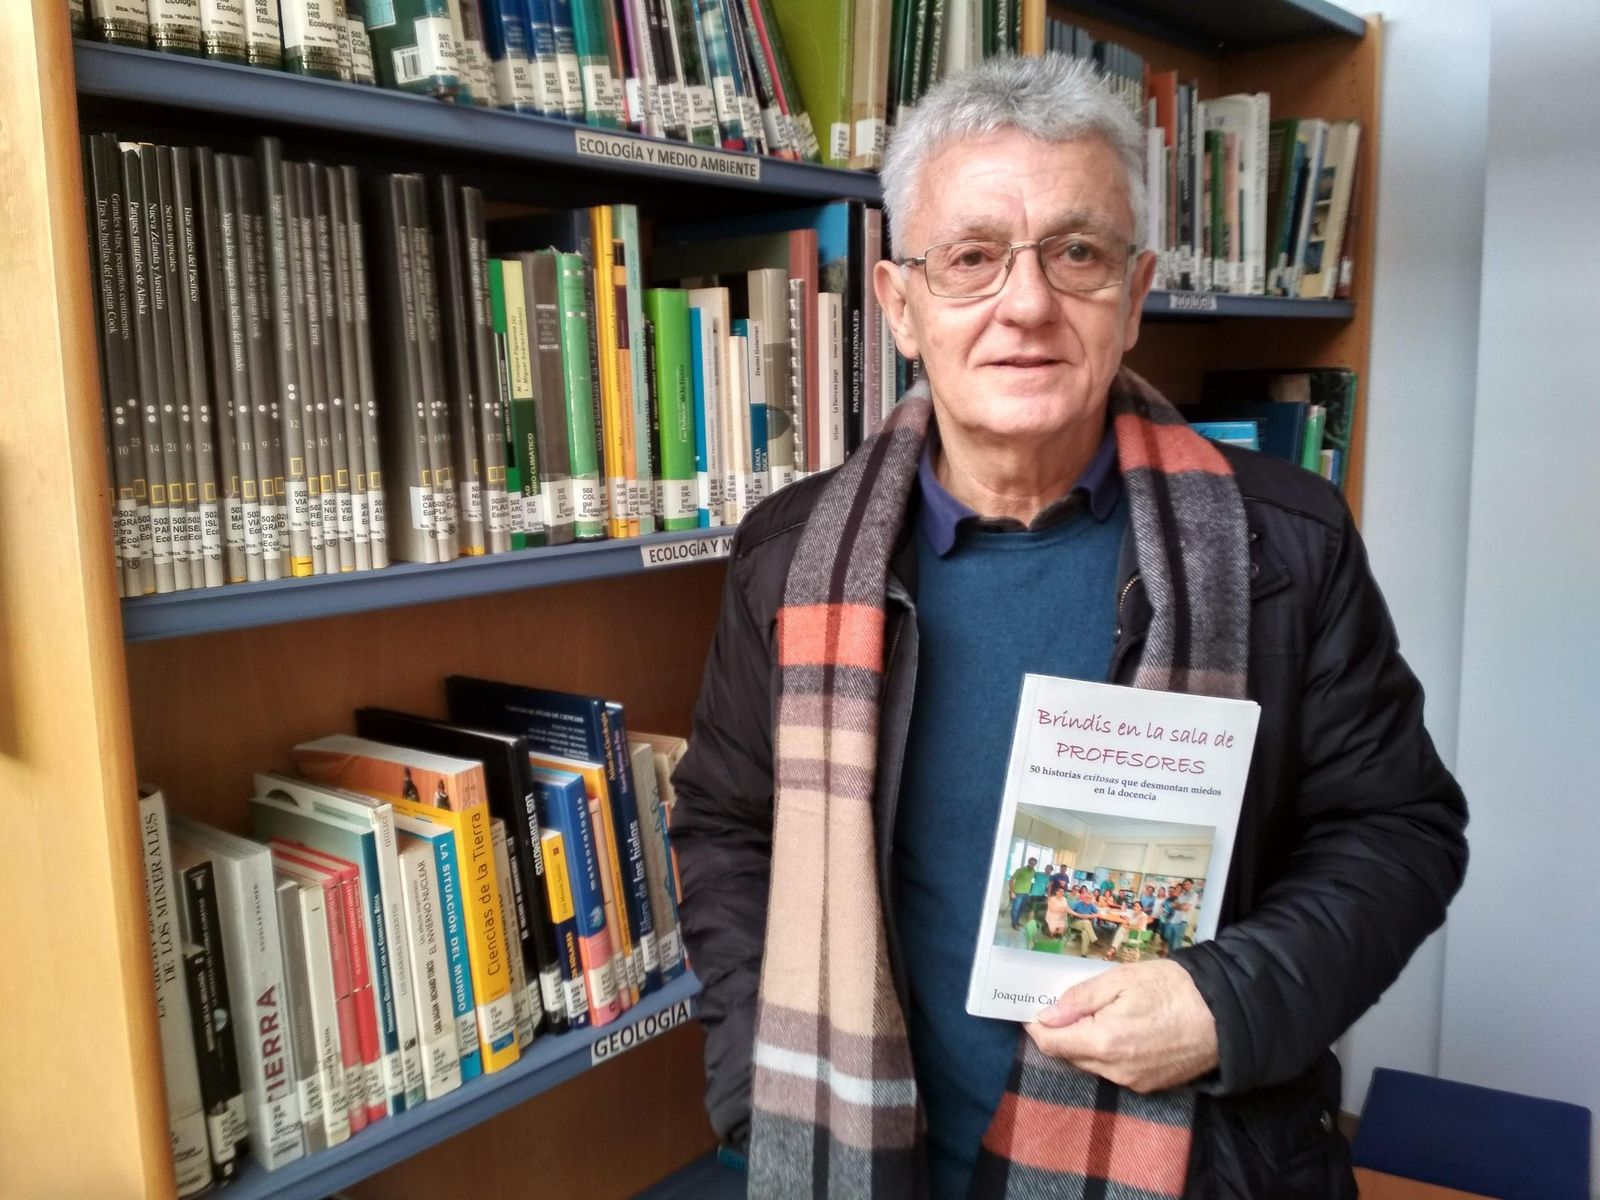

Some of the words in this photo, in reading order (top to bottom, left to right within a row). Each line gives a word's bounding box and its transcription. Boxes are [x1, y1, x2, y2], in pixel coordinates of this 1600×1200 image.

[579, 137, 644, 161] ECOLOGÍA
[646, 147, 654, 162] Y
[657, 150, 697, 168] MEDIO
[701, 156, 758, 177] AMBIENTE
[98, 200, 110, 217] Tras
[111, 193, 123, 227] Grandes
[128, 201, 141, 234] Parques
[148, 202, 160, 230] Nueva
[165, 204, 176, 232] Selvas
[184, 207, 194, 226] Islas
[100, 218, 110, 232] las
[222, 213, 234, 235] Viajes
[101, 232, 113, 263] huellas
[132, 236, 144, 272] naturales
[151, 231, 162, 264] Zelanda
[165, 236, 178, 272] tropicales
[186, 227, 196, 253] azules
[225, 245, 236, 257] los
[103, 264, 114, 278] del
[188, 254, 197, 267] del
[224, 258, 238, 286] lugares
[135, 274, 145, 285] de
[154, 272, 165, 310] Australia
[189, 269, 199, 302] Pacífico
[102, 279, 116, 310] capitán
[136, 286, 147, 314] Alaska
[106, 311, 117, 334] Cook
[230, 305, 241, 330] bellos
[232, 330, 242, 343] del
[752, 325, 760, 354] Goleman
[233, 344, 244, 371] mundo
[871, 379, 880, 390] de
[870, 392, 880, 426] Sierra
[150, 444, 160, 453] 14
[186, 444, 191, 452] 6
[711, 540, 718, 552] Y
[1118, 722, 1140, 737] en
[1147, 722, 1164, 740] la
[1169, 727, 1208, 746] sala
[1214, 730, 1235, 748] de
[1056, 742, 1206, 775] PROFESORES
[1029, 764, 1041, 774] 50
[1042, 766, 1082, 780] historias
[1083, 772, 1120, 785] exitosas
[1121, 778, 1138, 788] que
[1140, 779, 1188, 794] desmontan
[1190, 786, 1222, 797] miedos
[1093, 788, 1106, 796] en
[1108, 787, 1116, 796] la
[1117, 789, 1157, 802] docencia
[524, 793, 536, 814] LOS
[439, 843, 450, 860] LA
[470, 813, 487, 862] Tierra
[527, 814, 544, 876] TERREMOTOS
[626, 820, 643, 860] hielos
[144, 812, 169, 919] MINERALES
[475, 863, 489, 880] la
[631, 861, 646, 882] los
[417, 860, 431, 901] NUCLEAR
[478, 884, 492, 904] de
[634, 882, 648, 898] de
[253, 884, 261, 914] PALMER
[441, 864, 457, 933] SITUACIÓN
[256, 916, 265, 952] DOUGLAS
[391, 903, 403, 946] DESIERTOS
[422, 903, 436, 943] INVIERNO
[157, 921, 174, 955] LOS
[427, 945, 437, 955] EL
[449, 937, 460, 961] DEL
[480, 909, 501, 976] Ciencias
[161, 960, 177, 984] DE
[395, 948, 406, 981] GRANDES
[398, 981, 408, 996] LOS
[452, 965, 466, 1012] MUNDO
[991, 989, 1035, 1006] Joaquín
